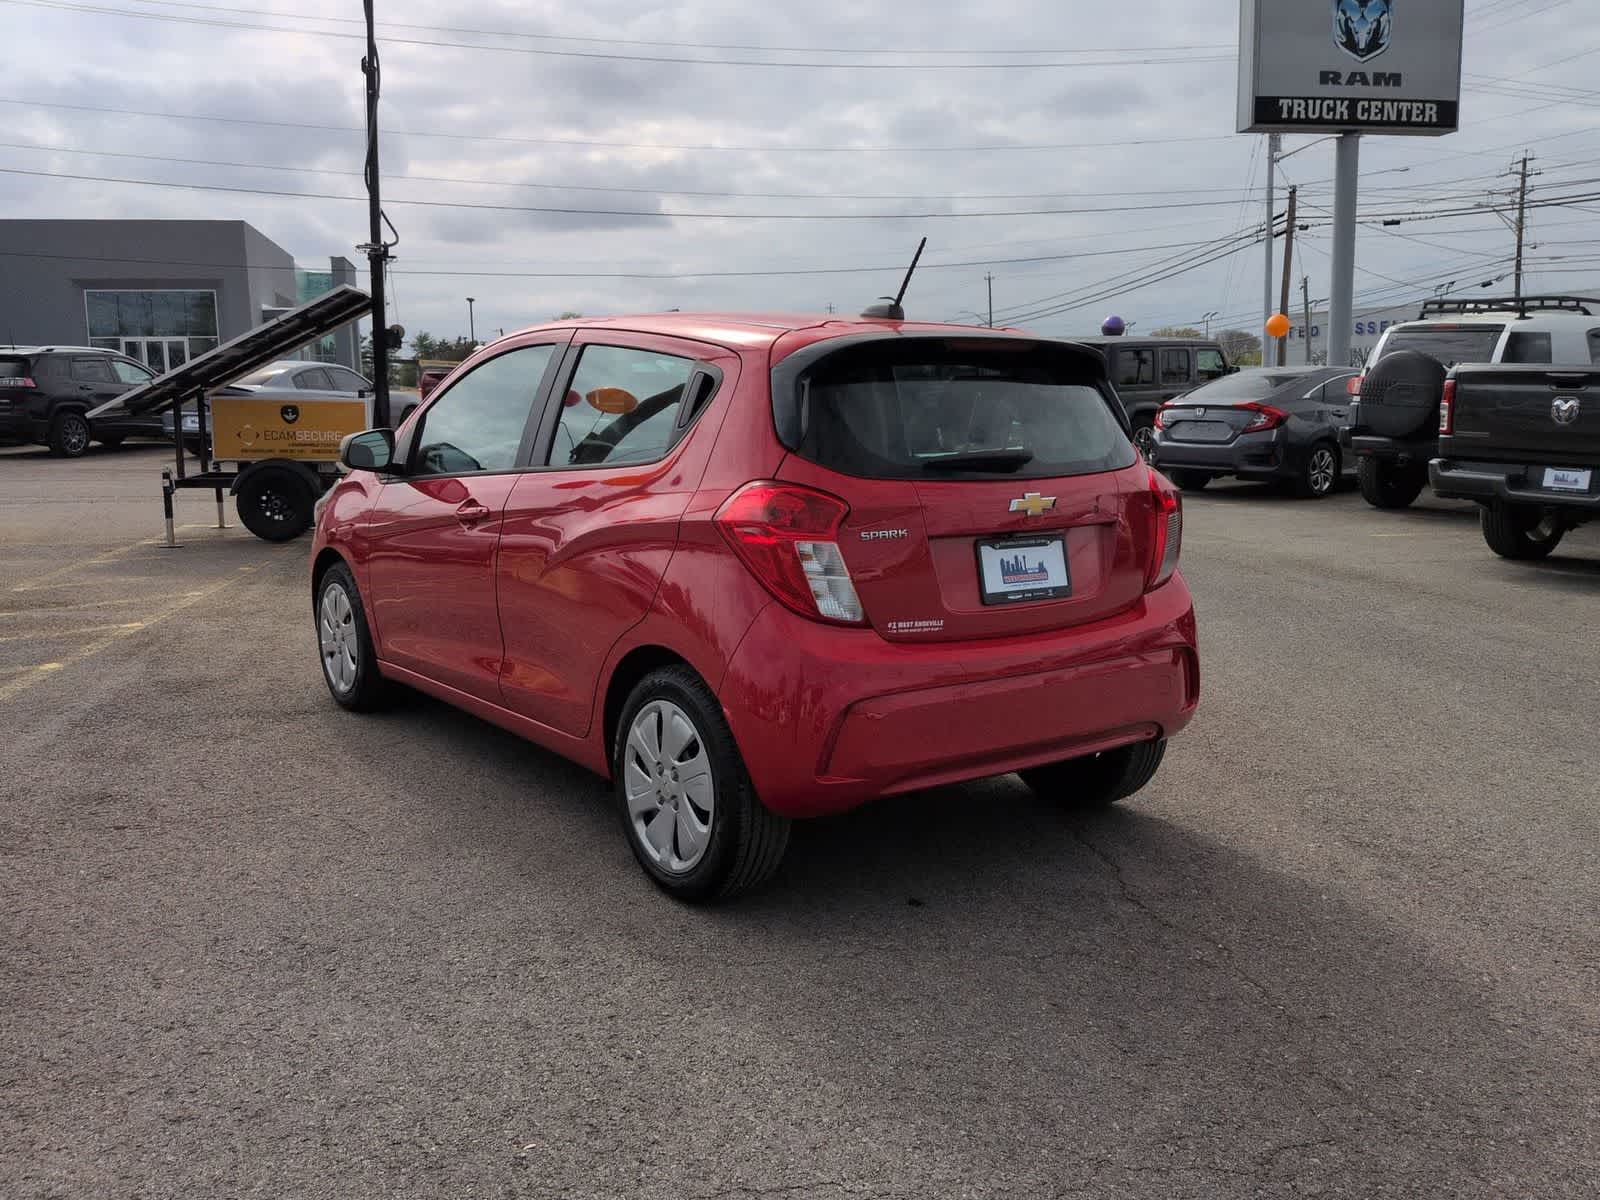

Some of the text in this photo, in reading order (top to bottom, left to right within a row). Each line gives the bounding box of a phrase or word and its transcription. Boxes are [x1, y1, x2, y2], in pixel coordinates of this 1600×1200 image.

[1319, 71, 1402, 87] RAM
[1278, 98, 1438, 122] TRUCK CENTER
[861, 529, 908, 541] SPARK
